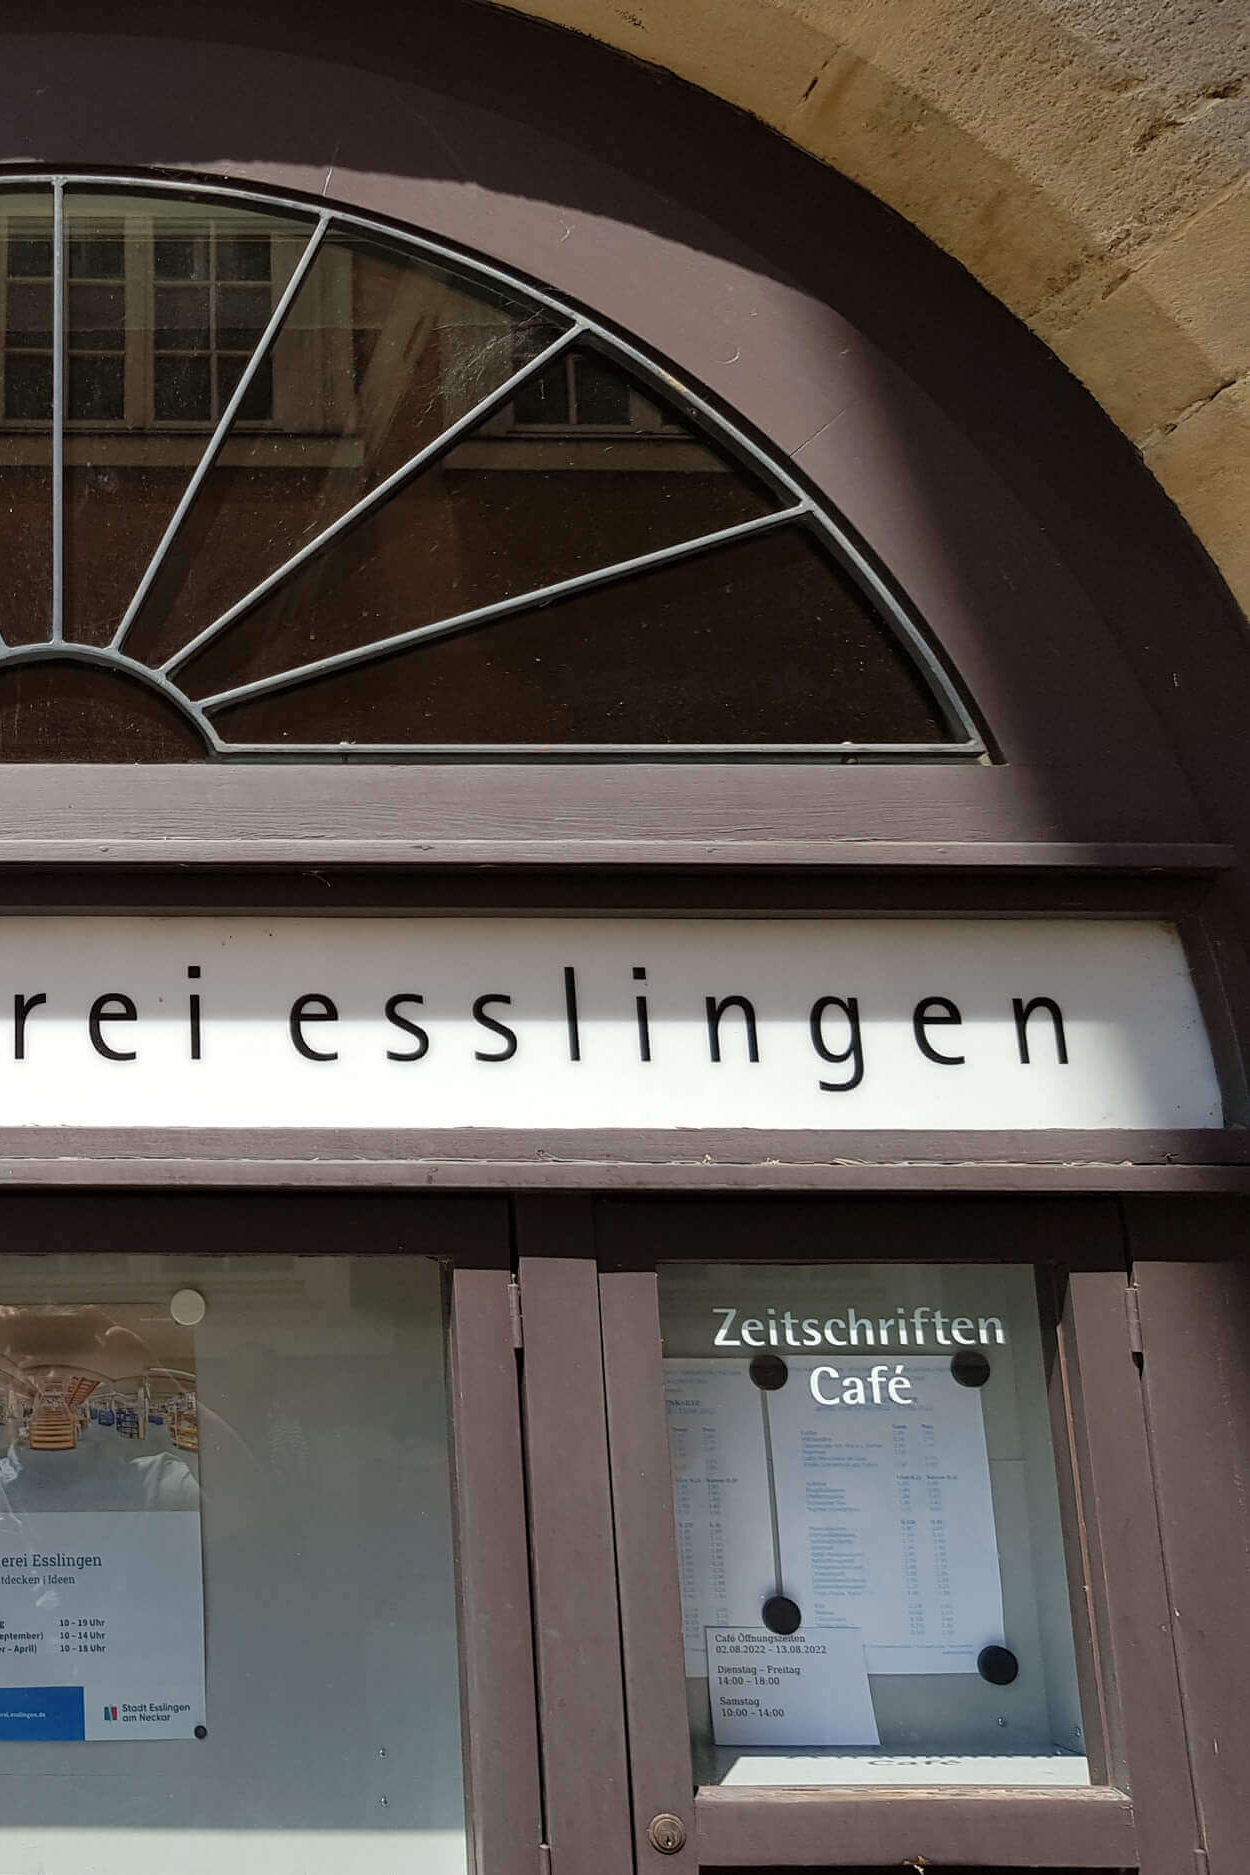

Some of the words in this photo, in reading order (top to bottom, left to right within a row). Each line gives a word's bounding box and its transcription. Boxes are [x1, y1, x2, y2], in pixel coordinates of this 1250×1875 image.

[287, 965, 1069, 1093] esslingen
[711, 1307, 1006, 1348] Zeitschriften
[809, 1365, 913, 1406] Café
[32, 1553, 103, 1570] Esslingen
[47, 1574, 76, 1585] Ideen
[89, 1618, 106, 1627] Uhr
[89, 1630, 106, 1640] Uhr
[737, 1632, 806, 1645] Öffnungszeiten
[14, 1644, 37, 1655] April)
[90, 1643, 107, 1653] Uhr
[715, 1645, 766, 1654] 02.08.2022
[776, 1645, 828, 1654] 13.08.2022
[717, 1665, 757, 1675] Dienstag
[766, 1665, 801, 1676] Freitag
[717, 1676, 744, 1685] 14:00
[754, 1676, 780, 1685] 18:00
[719, 1696, 760, 1707] Samstag
[121, 1703, 147, 1713] Stadt
[149, 1702, 191, 1714] Esslingen
[721, 1708, 748, 1717] 10:00
[758, 1708, 785, 1717] 14:00
[122, 1714, 137, 1722] am
[139, 1713, 171, 1722] Neckar
